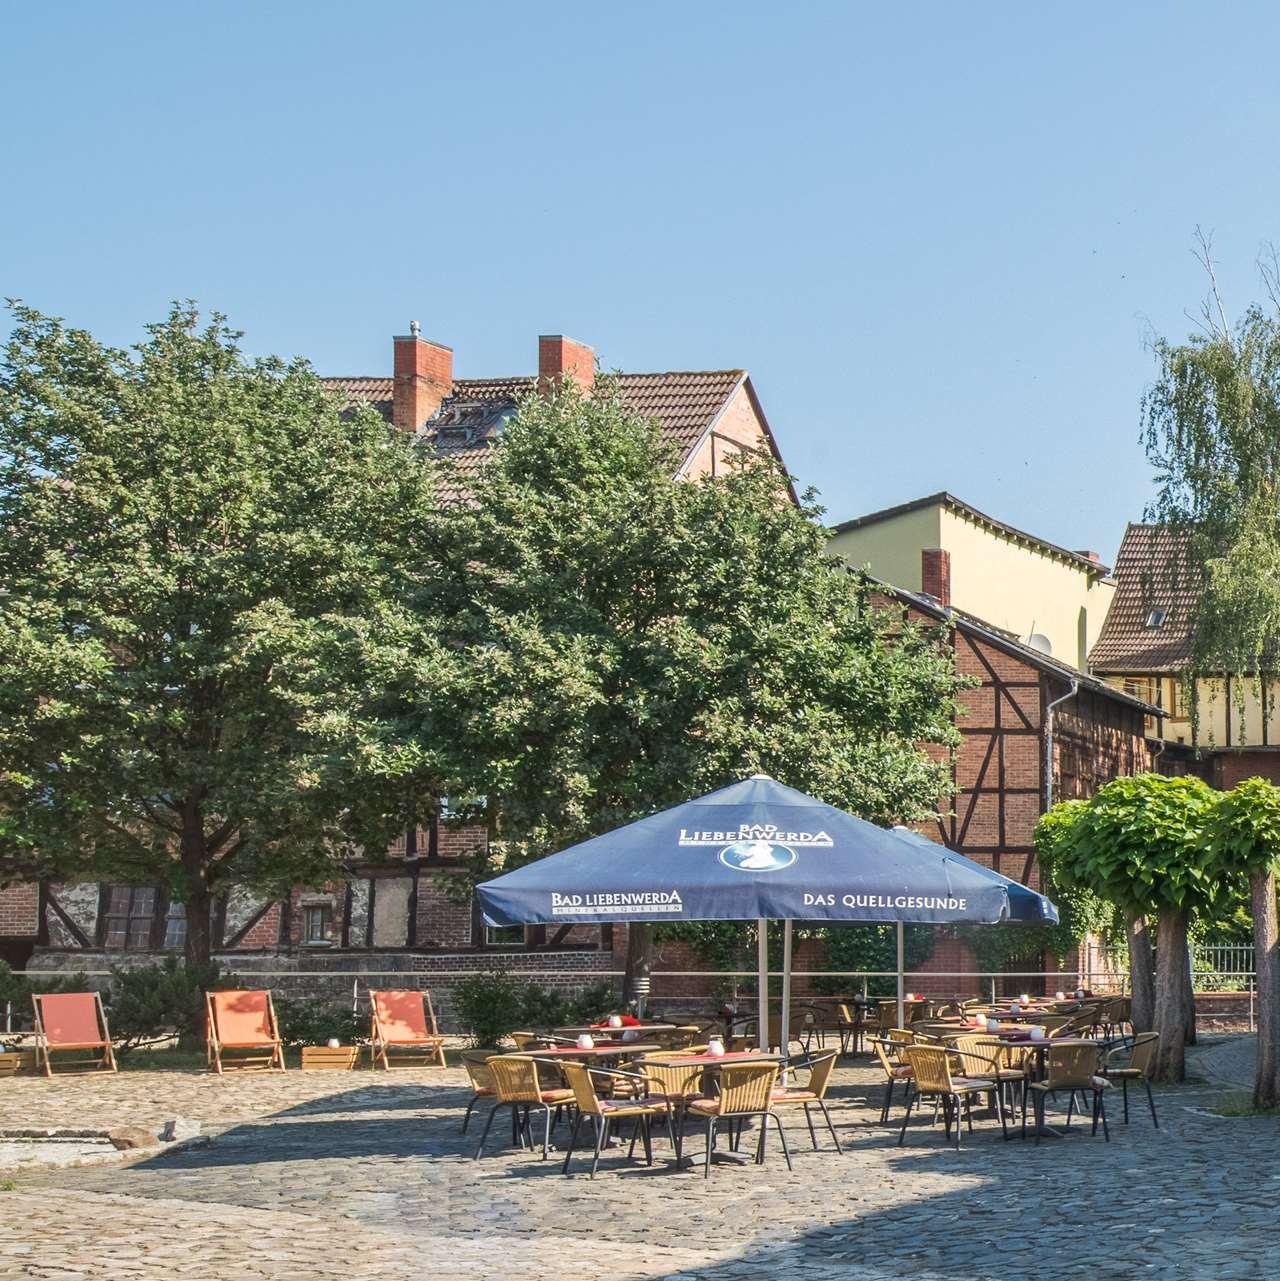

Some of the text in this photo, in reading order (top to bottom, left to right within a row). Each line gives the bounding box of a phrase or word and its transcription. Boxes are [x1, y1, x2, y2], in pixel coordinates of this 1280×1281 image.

[679, 829, 833, 841] LIEBENWERDA
[739, 824, 778, 832] BAD
[551, 889, 682, 906] BAD LIEBENWERDA
[803, 893, 967, 910] DAS QUELLGESUNDE
